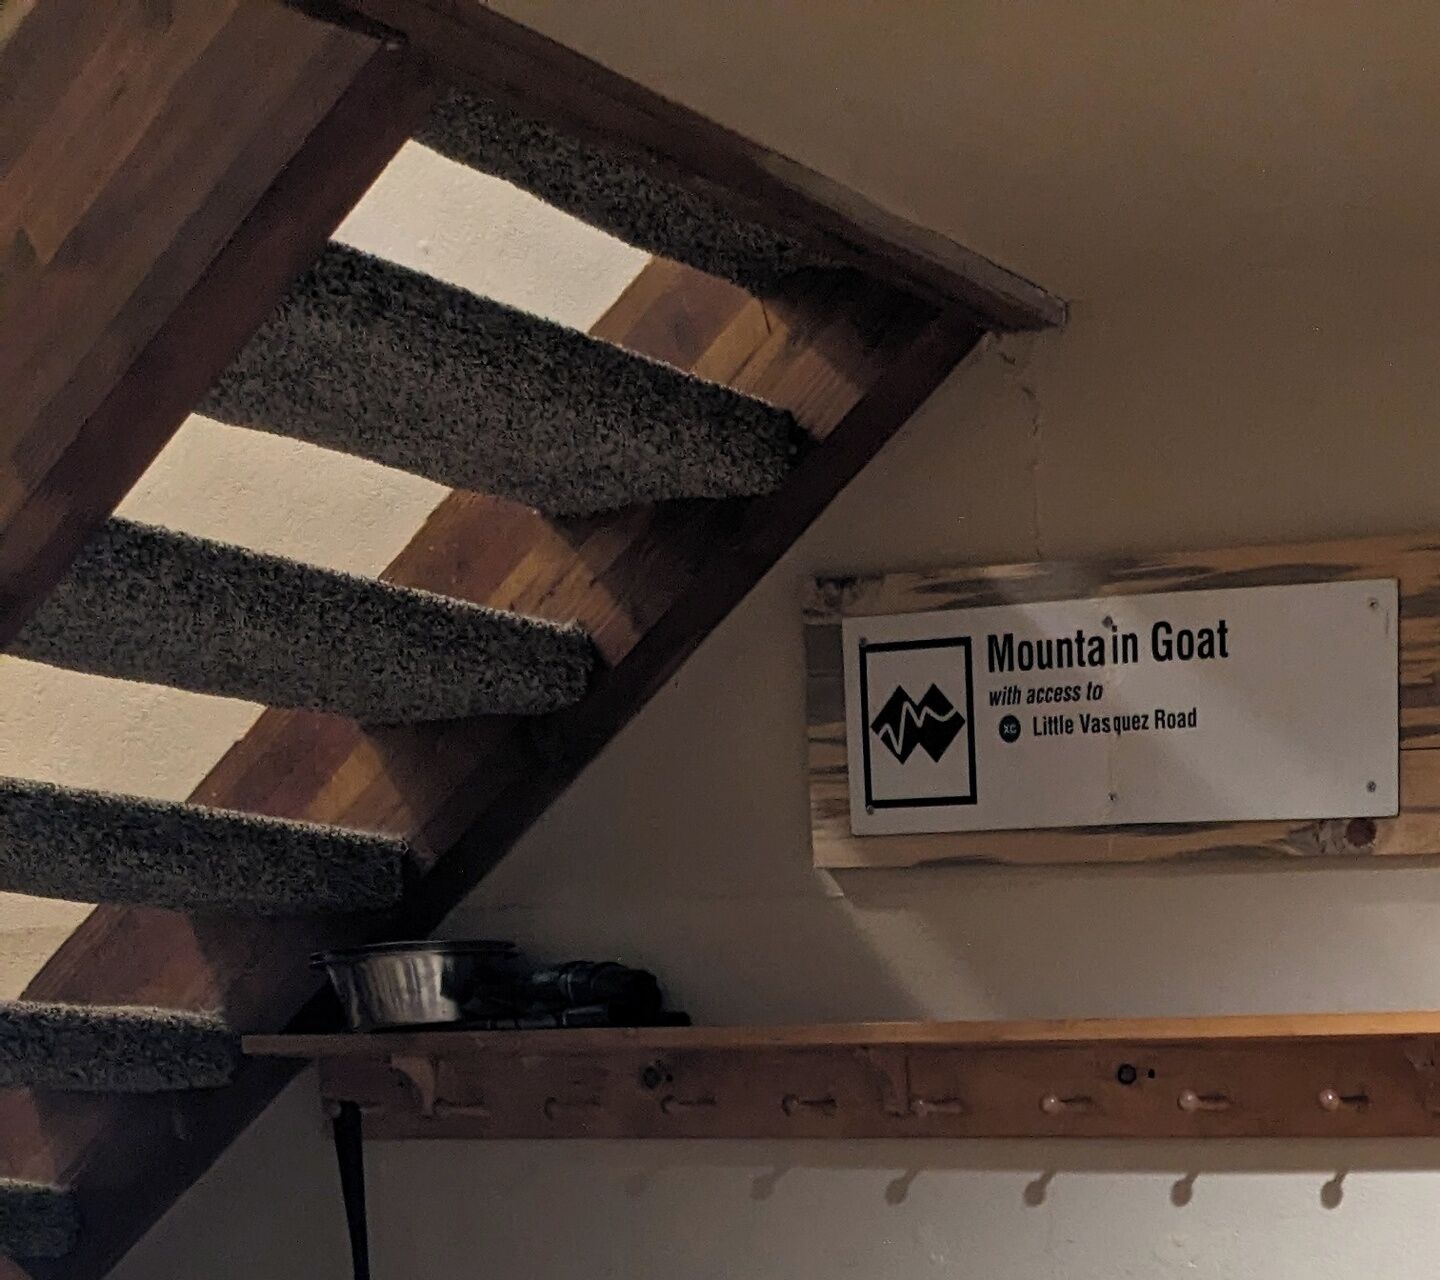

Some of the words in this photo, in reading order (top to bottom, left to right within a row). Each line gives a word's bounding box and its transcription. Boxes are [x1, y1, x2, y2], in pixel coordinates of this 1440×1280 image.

[988, 625, 1139, 673] Mountain
[1151, 619, 1230, 662] Goat
[989, 685, 1022, 707] with
[1026, 684, 1081, 705] access
[1085, 681, 1104, 702] to
[1033, 714, 1075, 737] Little
[1079, 710, 1150, 736] Vasquez
[1154, 707, 1198, 730] Road
